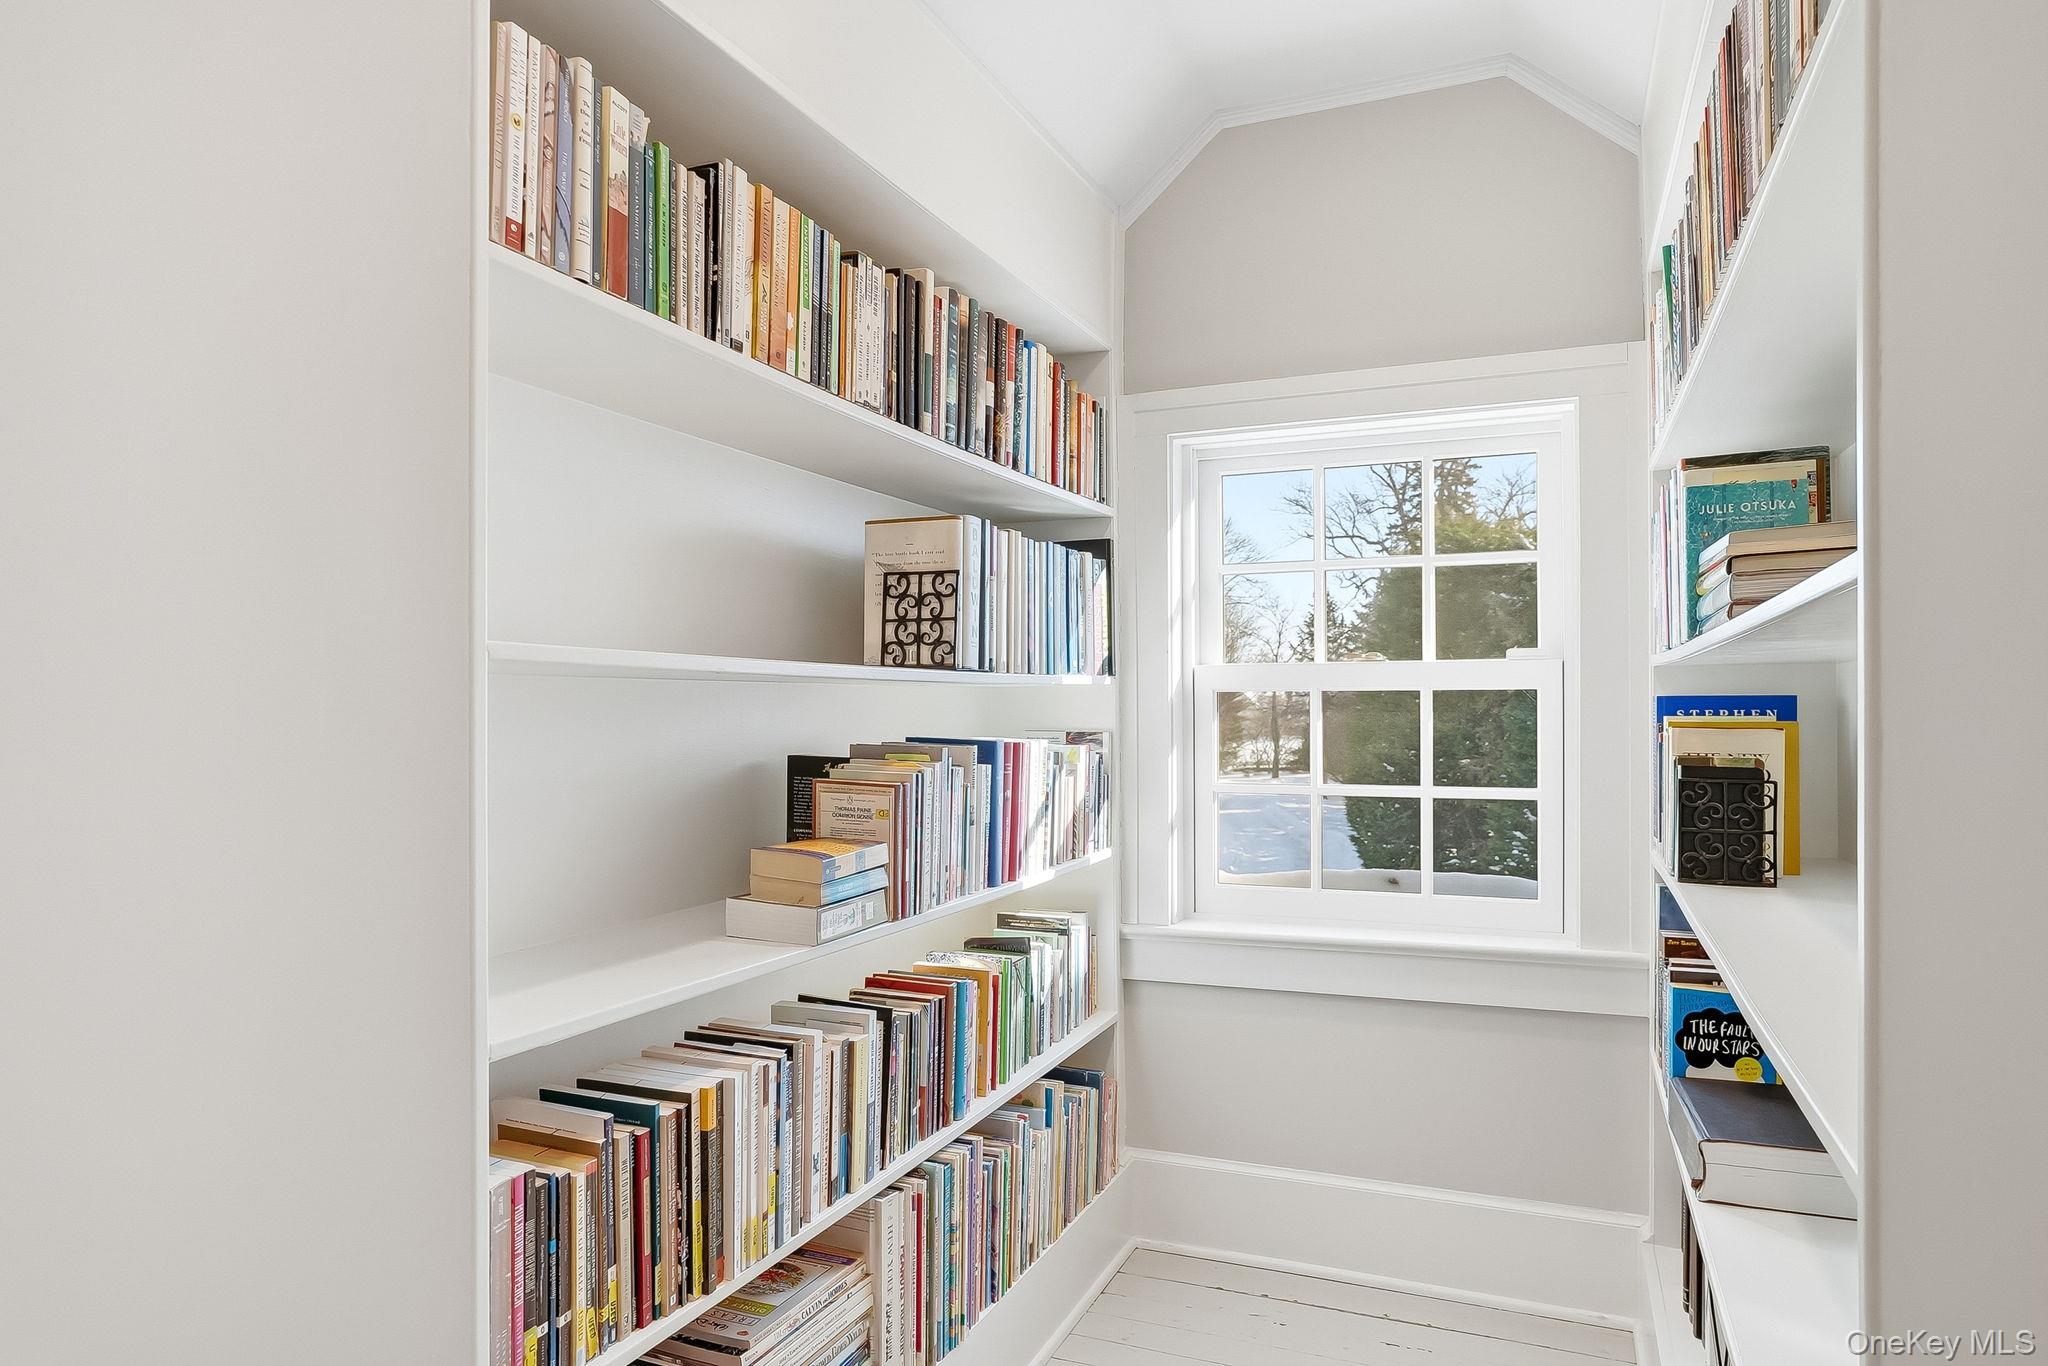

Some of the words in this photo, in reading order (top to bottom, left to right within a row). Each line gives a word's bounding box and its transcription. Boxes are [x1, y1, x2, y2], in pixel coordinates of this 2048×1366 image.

[1699, 503, 1735, 515] JULIE
[1740, 500, 1797, 512] OTSUKA
[1690, 1018, 1718, 1035] THE
[1720, 1021, 1755, 1040] FAULT
[1683, 1036, 1697, 1050] IN
[1698, 1039, 1720, 1053] OUR
[1722, 1039, 1760, 1057] STARS
[801, 1298, 823, 1320] CALVIN
[827, 1280, 848, 1299] HOBBES
